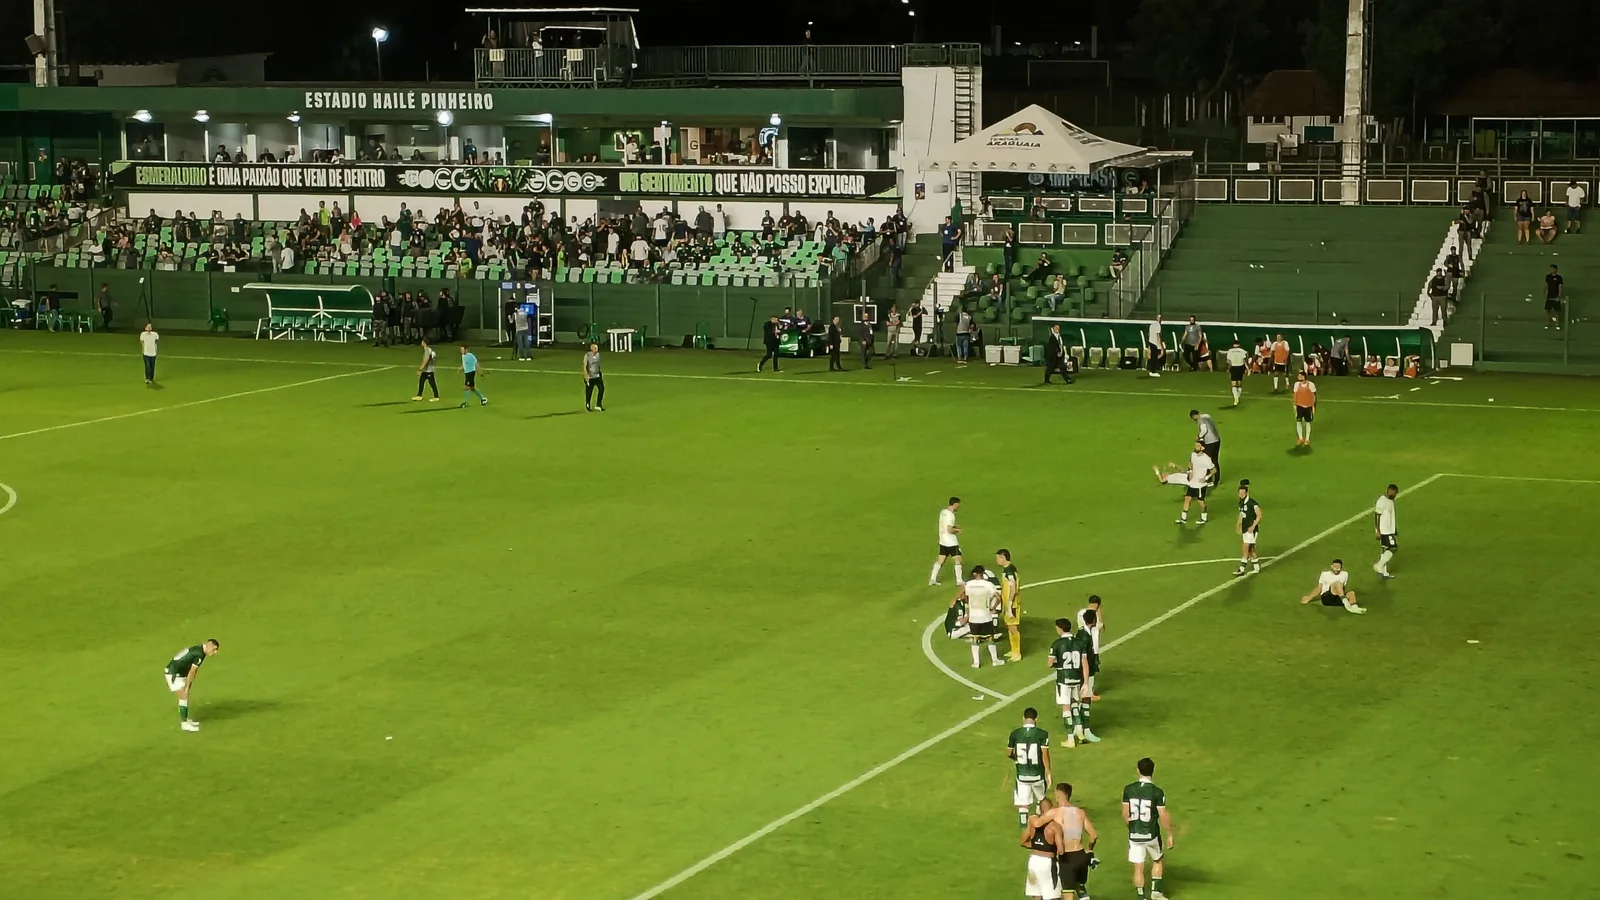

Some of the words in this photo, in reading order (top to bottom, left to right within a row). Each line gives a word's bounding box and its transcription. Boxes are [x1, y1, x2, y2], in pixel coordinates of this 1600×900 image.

[372, 90, 416, 109] HAILÉ
[421, 92, 494, 110] PINHEIRO
[690, 140, 699, 150] G
[135, 166, 207, 186] ESMERALDINO
[208, 165, 215, 186] É
[216, 167, 241, 187] UMA
[242, 166, 280, 187] PAIXÃO
[281, 168, 303, 189] QUE
[303, 168, 327, 188] VEM
[328, 168, 343, 188] DE
[343, 168, 386, 188] DENTRO
[618, 172, 639, 192] UM
[640, 172, 713, 193] SENTIMENTO
[715, 173, 738, 195] QUE
[739, 171, 764, 193] NÃO
[765, 173, 806, 194] POSSO
[808, 174, 866, 195] EXPLICAR
[1016, 742, 1039, 765] 54
[1128, 798, 1152, 823] 55
